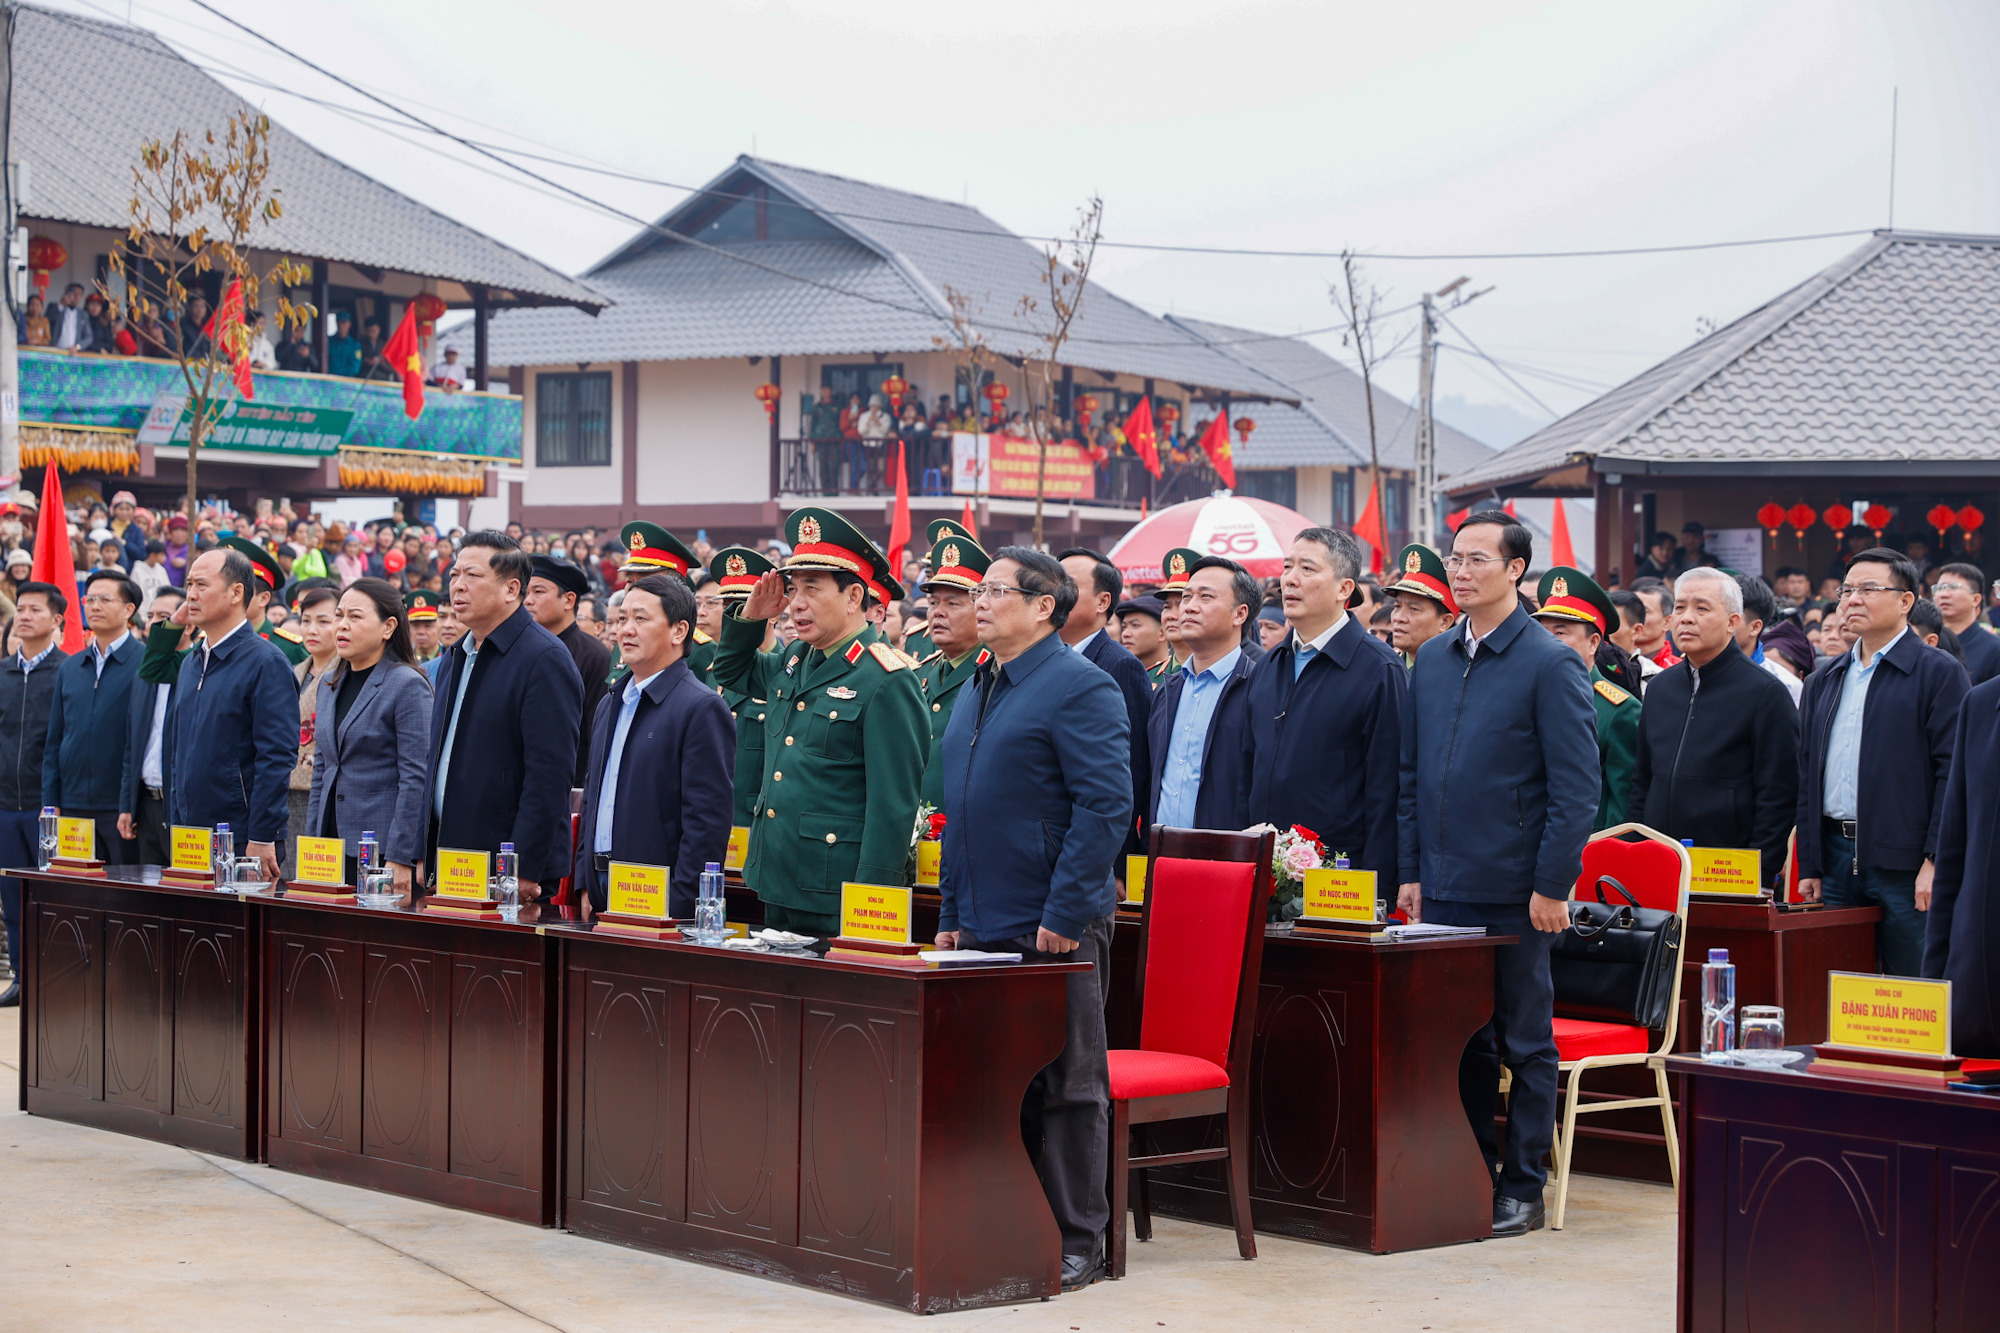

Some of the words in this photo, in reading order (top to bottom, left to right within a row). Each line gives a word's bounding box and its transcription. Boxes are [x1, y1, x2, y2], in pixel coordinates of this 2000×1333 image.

[1208, 532, 1258, 555] 5G
[326, 854, 337, 863] MINH
[618, 881, 630, 892] PHAN
[632, 881, 642, 893] VĂN
[643, 884, 658, 895] GIANG
[1328, 889, 1341, 899] NGỌC
[854, 907, 867, 918] PHẠM
[869, 909, 881, 918] MINH
[883, 910, 897, 920] CHÍNH
[1875, 986, 1891, 998] ĐỒNG
[1892, 988, 1902, 998] CHÍ
[1841, 999, 1869, 1018] ĐẶNG
[1871, 1003, 1899, 1020] XUÂN
[1902, 1007, 1937, 1023] PHONG
